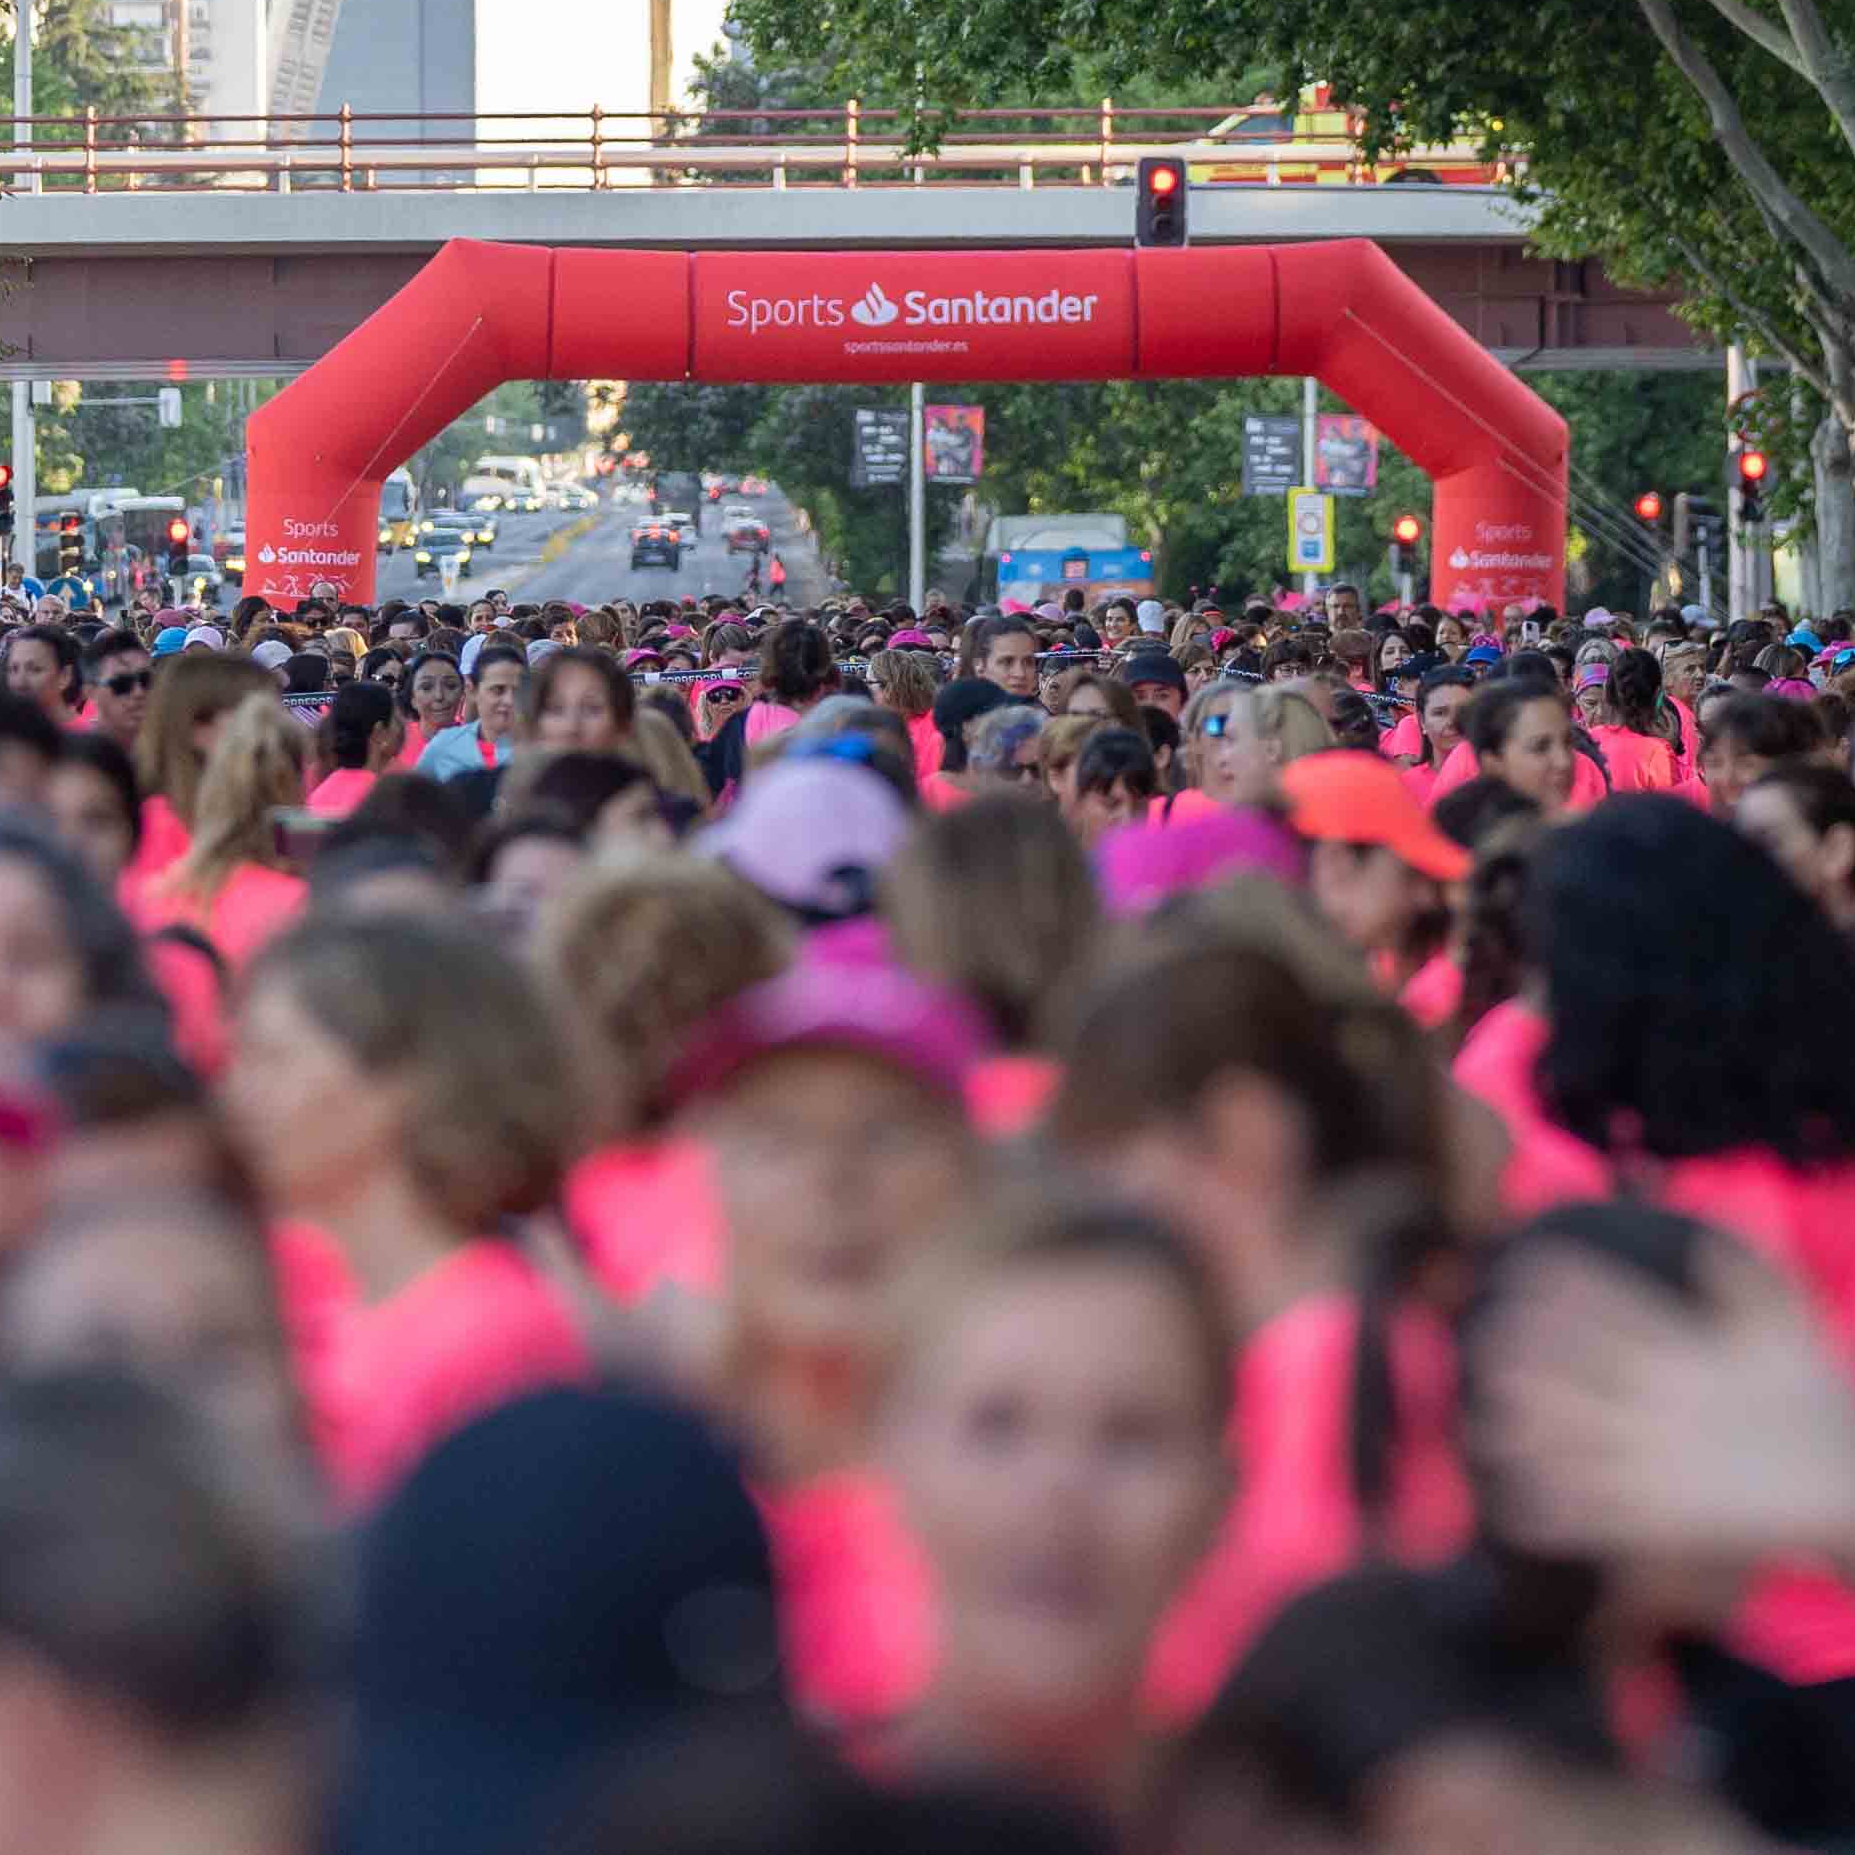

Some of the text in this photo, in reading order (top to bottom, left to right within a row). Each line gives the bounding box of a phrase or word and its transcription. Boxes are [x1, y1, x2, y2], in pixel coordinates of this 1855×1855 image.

[726, 290, 1098, 334] Sports Santander
[283, 518, 338, 538] Sports
[278, 547, 362, 565] Santander
